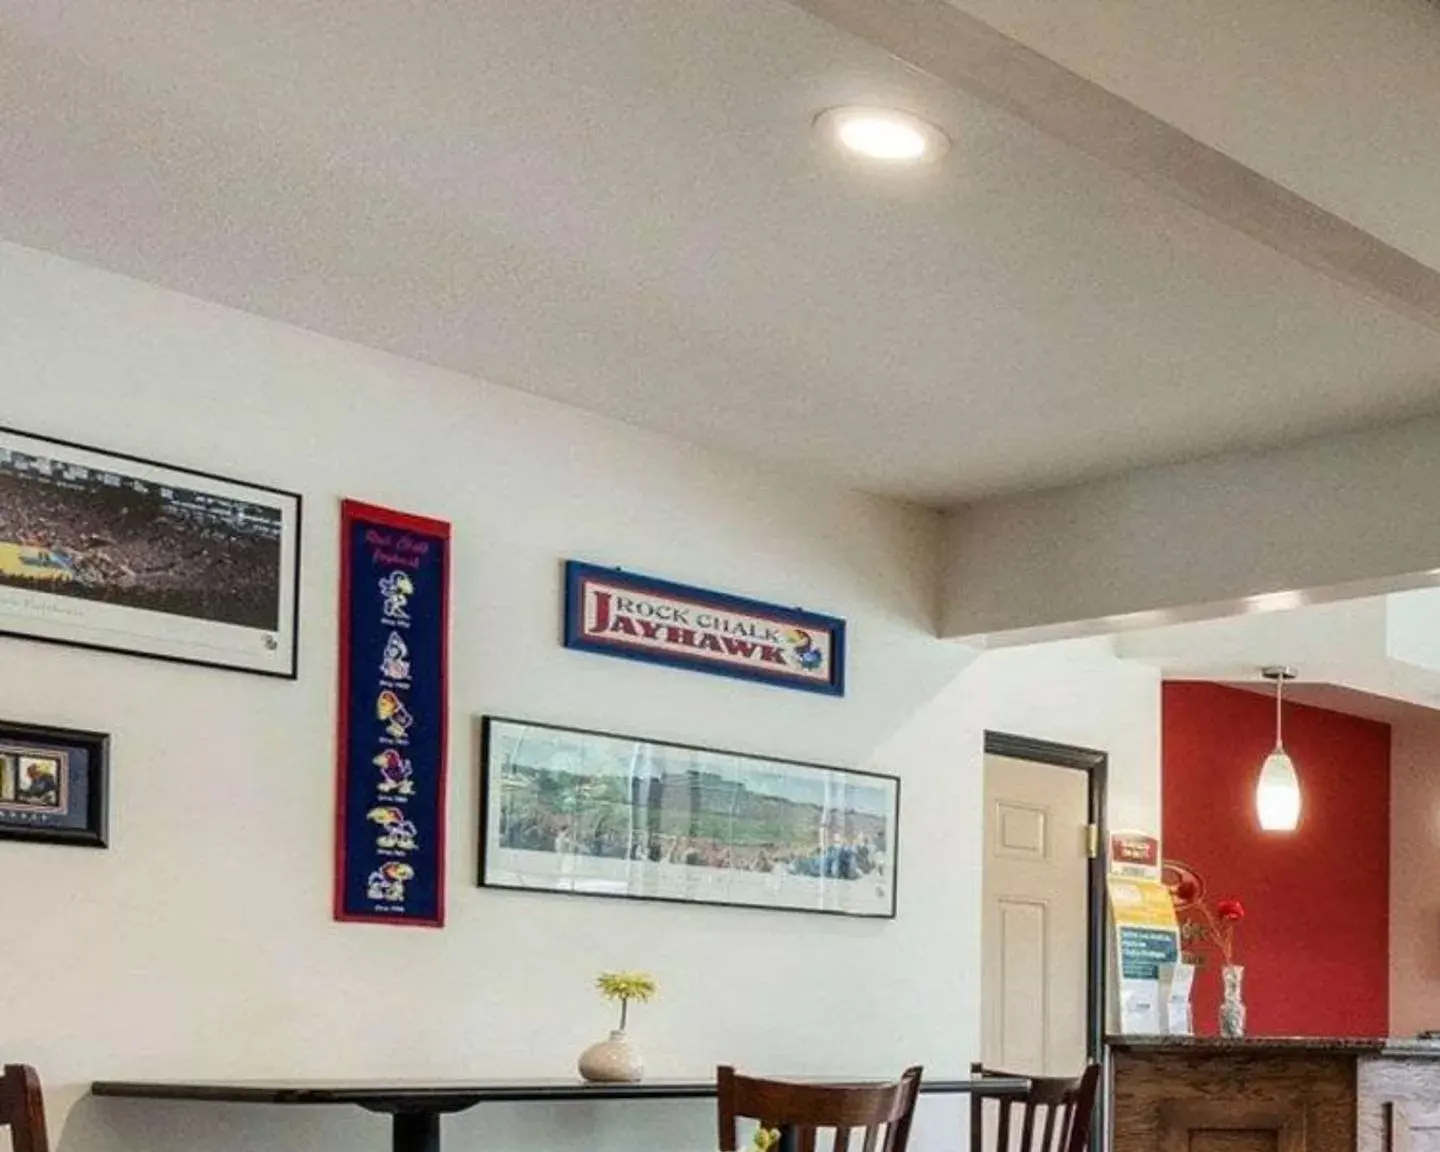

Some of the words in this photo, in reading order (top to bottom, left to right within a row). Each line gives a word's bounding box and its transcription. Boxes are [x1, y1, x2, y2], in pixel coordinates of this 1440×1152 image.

[589, 591, 788, 665] JAYHAWK
[616, 596, 689, 625] ROCK
[695, 613, 780, 644] CHALK
